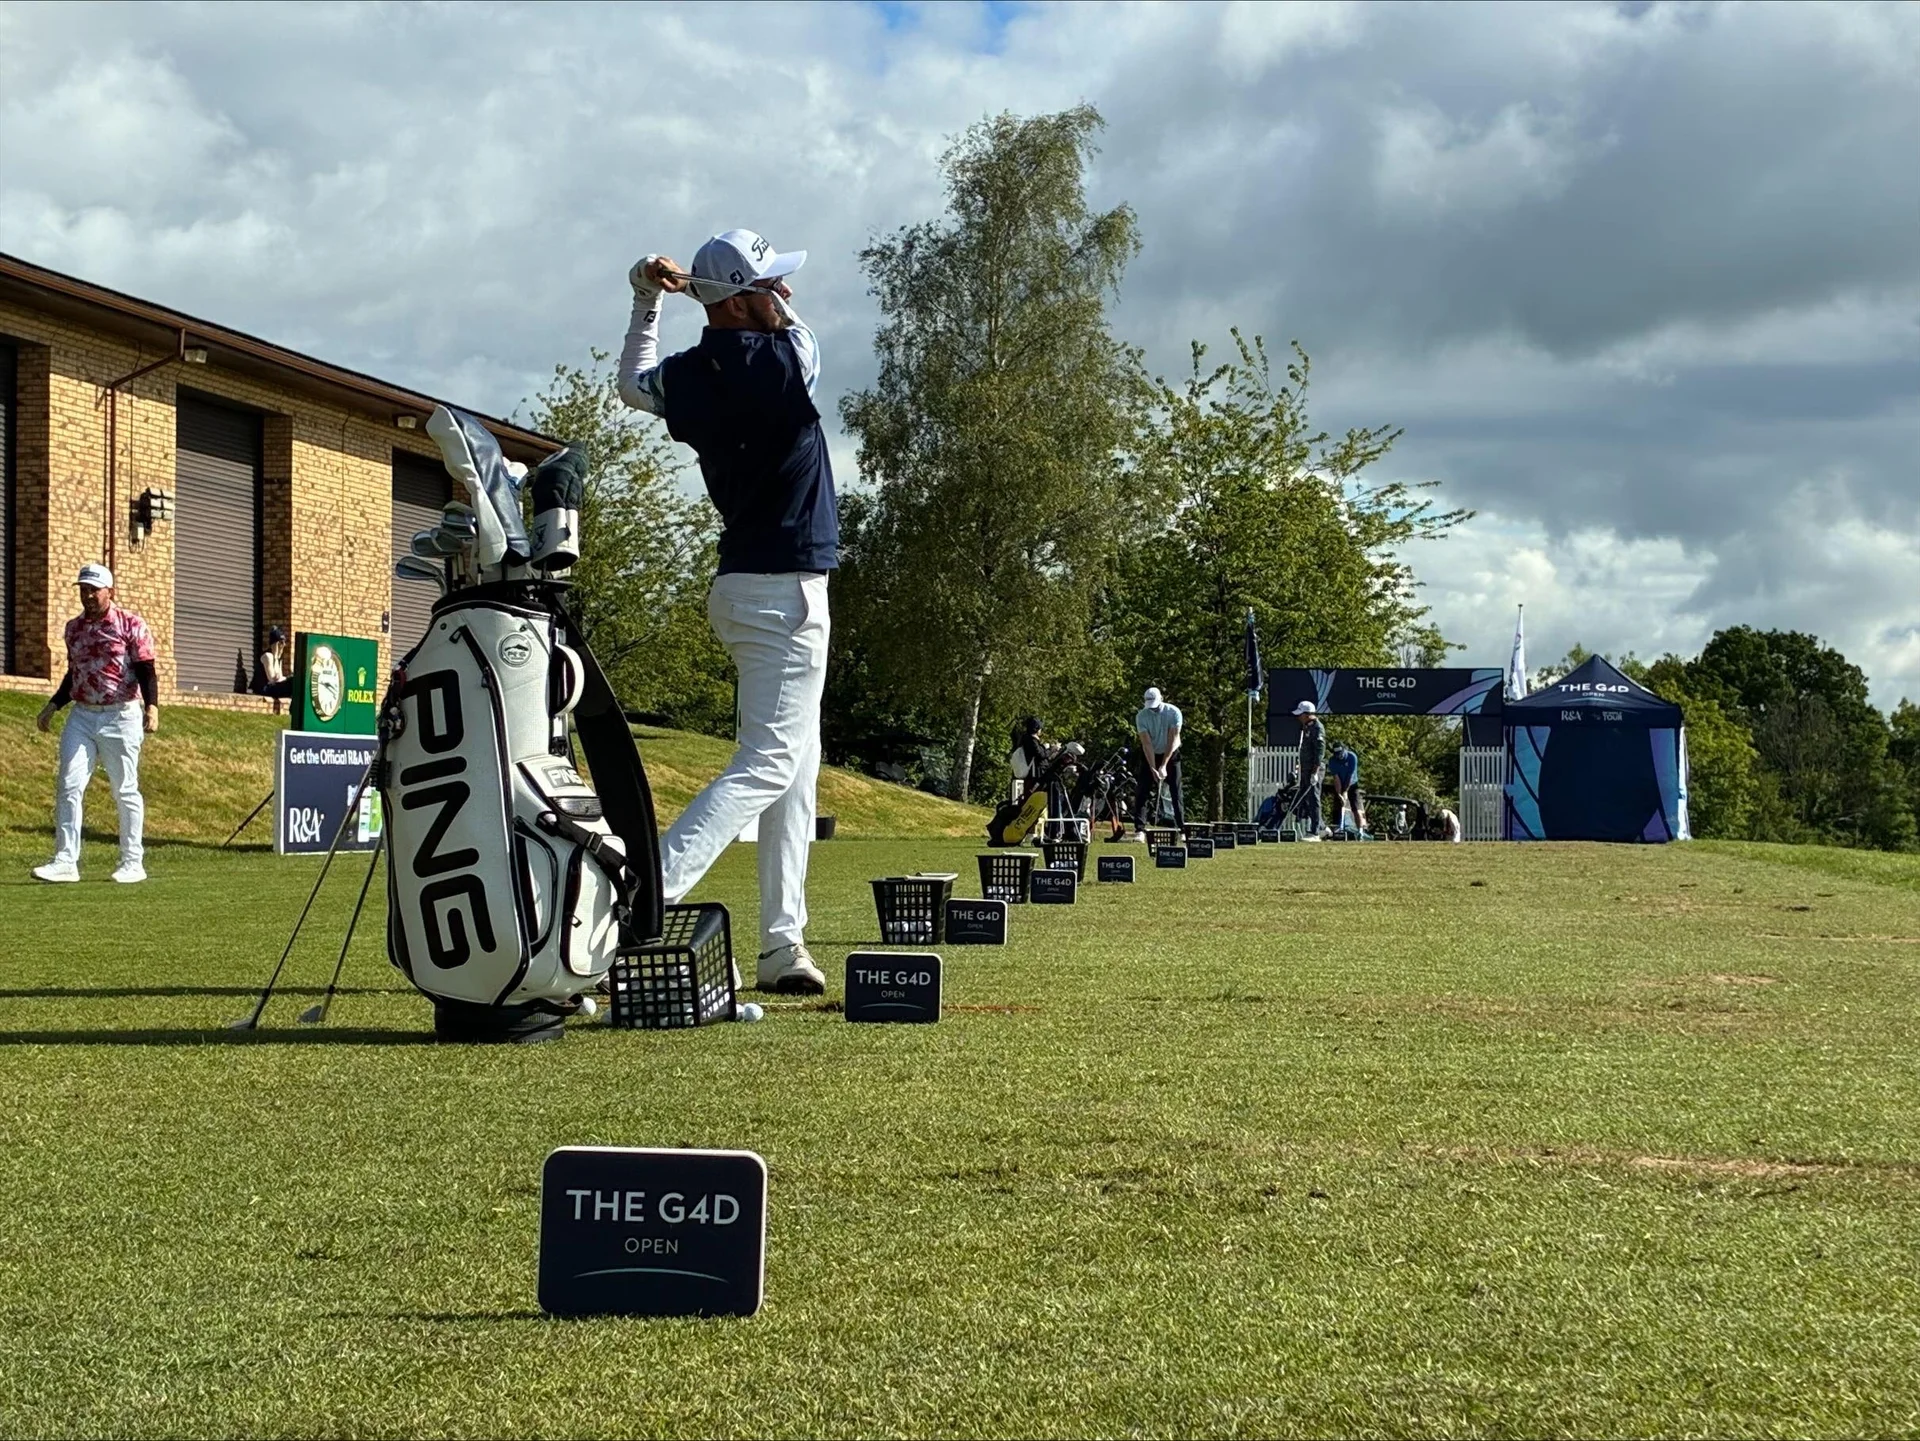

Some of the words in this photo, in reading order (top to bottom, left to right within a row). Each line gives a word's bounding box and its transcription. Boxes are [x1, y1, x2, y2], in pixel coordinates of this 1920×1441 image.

[1356, 676, 1385, 688] THE
[1387, 676, 1417, 689] G4D
[1558, 683, 1591, 692] THE
[1595, 683, 1629, 693] G4D
[347, 689, 374, 704] ROLEX
[289, 747, 305, 765] Get
[306, 748, 320, 765] the
[320, 748, 347, 765] Official
[347, 749, 363, 766] R&A
[288, 807, 325, 843] R&A
[401, 668, 497, 970] PING
[1054, 878, 1072, 886] G4D
[951, 910, 973, 920] THE
[976, 911, 1000, 921] G4D
[855, 970, 890, 984] THE
[895, 971, 931, 986] G4D
[881, 990, 905, 998] OPEN
[566, 1189, 645, 1222] THE
[658, 1192, 740, 1225] G4D
[624, 1237, 679, 1254] OPEN
